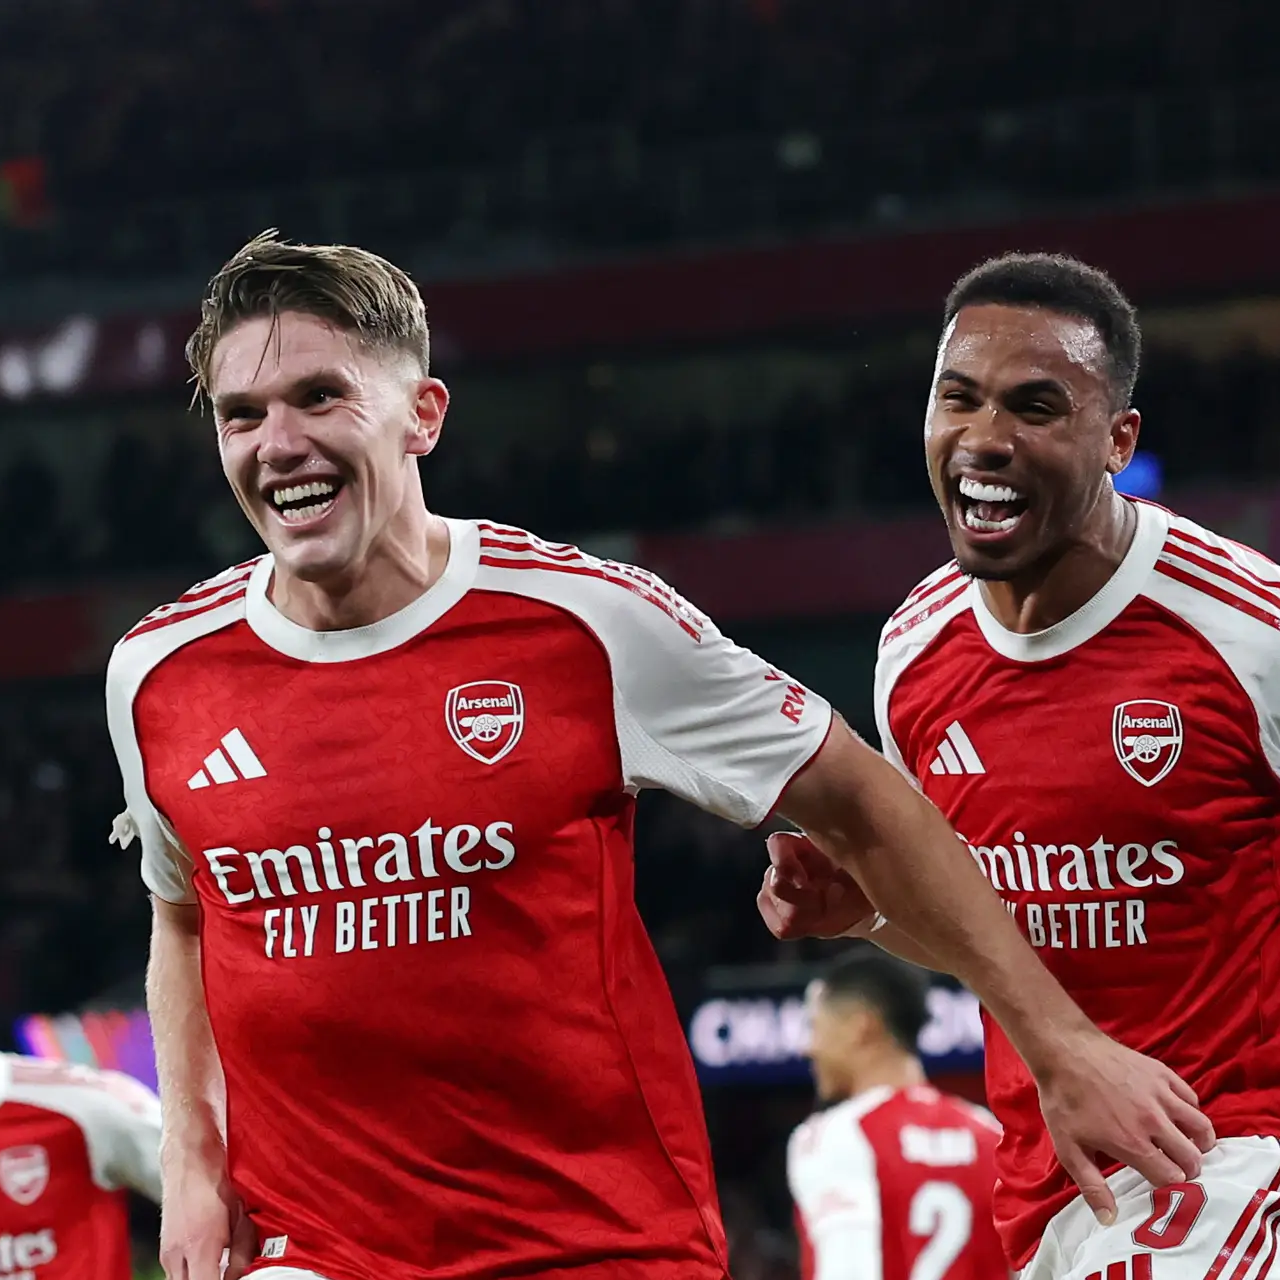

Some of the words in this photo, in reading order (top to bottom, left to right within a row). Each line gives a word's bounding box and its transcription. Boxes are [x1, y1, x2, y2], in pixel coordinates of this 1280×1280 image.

[457, 694, 512, 710] Arsenal
[1122, 715, 1172, 729] Arsenal
[203, 817, 516, 905] Emirates
[955, 831, 1185, 892] mirates
[264, 904, 318, 959] FLY
[335, 886, 473, 954] BETTER
[1026, 899, 1148, 949] BETTER
